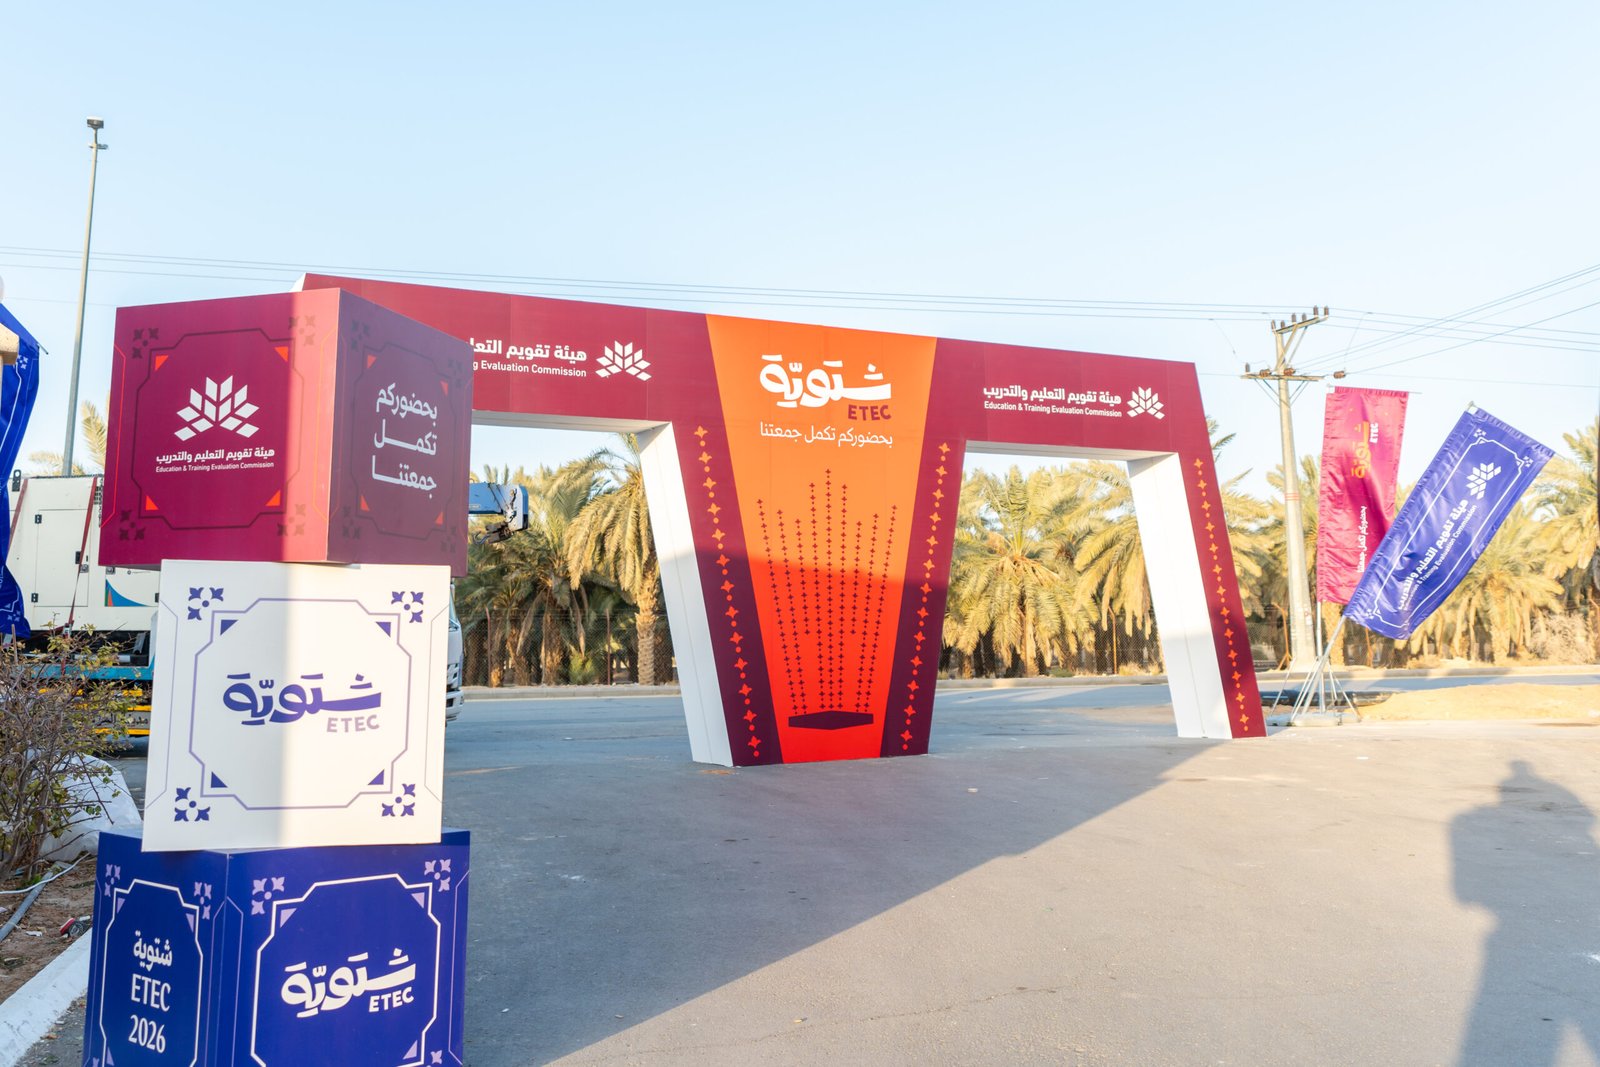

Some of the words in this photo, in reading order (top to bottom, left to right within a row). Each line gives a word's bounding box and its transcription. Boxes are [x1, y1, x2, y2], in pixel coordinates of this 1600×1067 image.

[506, 344, 551, 361] تقويم
[553, 345, 587, 364] هيئة
[480, 360, 529, 373] Evaluation
[531, 364, 587, 377] Commission
[983, 384, 1028, 401] والتدريب
[1030, 386, 1065, 402] التعليم
[1067, 391, 1097, 405] تقويم
[1099, 391, 1122, 407] هيئة
[376, 382, 438, 427] بحضوركم
[848, 404, 892, 421] ETEC
[984, 401, 1017, 410] Education
[1017, 403, 1023, 411] &
[1023, 403, 1050, 414] Training
[1051, 405, 1084, 414] Evaluation
[1084, 407, 1122, 417] Commission
[760, 421, 802, 443] جمعتنا
[804, 425, 836, 443] تكمل
[838, 427, 893, 448] بحضوركم
[1370, 422, 1379, 443] ETEC
[156, 451, 193, 465] والتدريب
[194, 449, 225, 463] التعليم
[226, 448, 253, 461] تقويم
[254, 447, 275, 459] هيئة
[155, 465, 182, 473] Education
[187, 464, 210, 472] Training
[240, 461, 274, 469] Commission
[1450, 499, 1469, 521] هيئة
[1358, 534, 1367, 551] تكمل
[1422, 564, 1439, 582] Training
[1434, 538, 1456, 566] Evaluation
[1452, 504, 1477, 538] Commission
[1435, 519, 1455, 549] تقويم
[1416, 547, 1438, 574] التعليم
[326, 714, 380, 734] ETEC
[133, 930, 173, 972] شتوية
[131, 973, 171, 1012] ETEC
[368, 986, 414, 1013] ETEC
[128, 1014, 166, 1054] 2026
